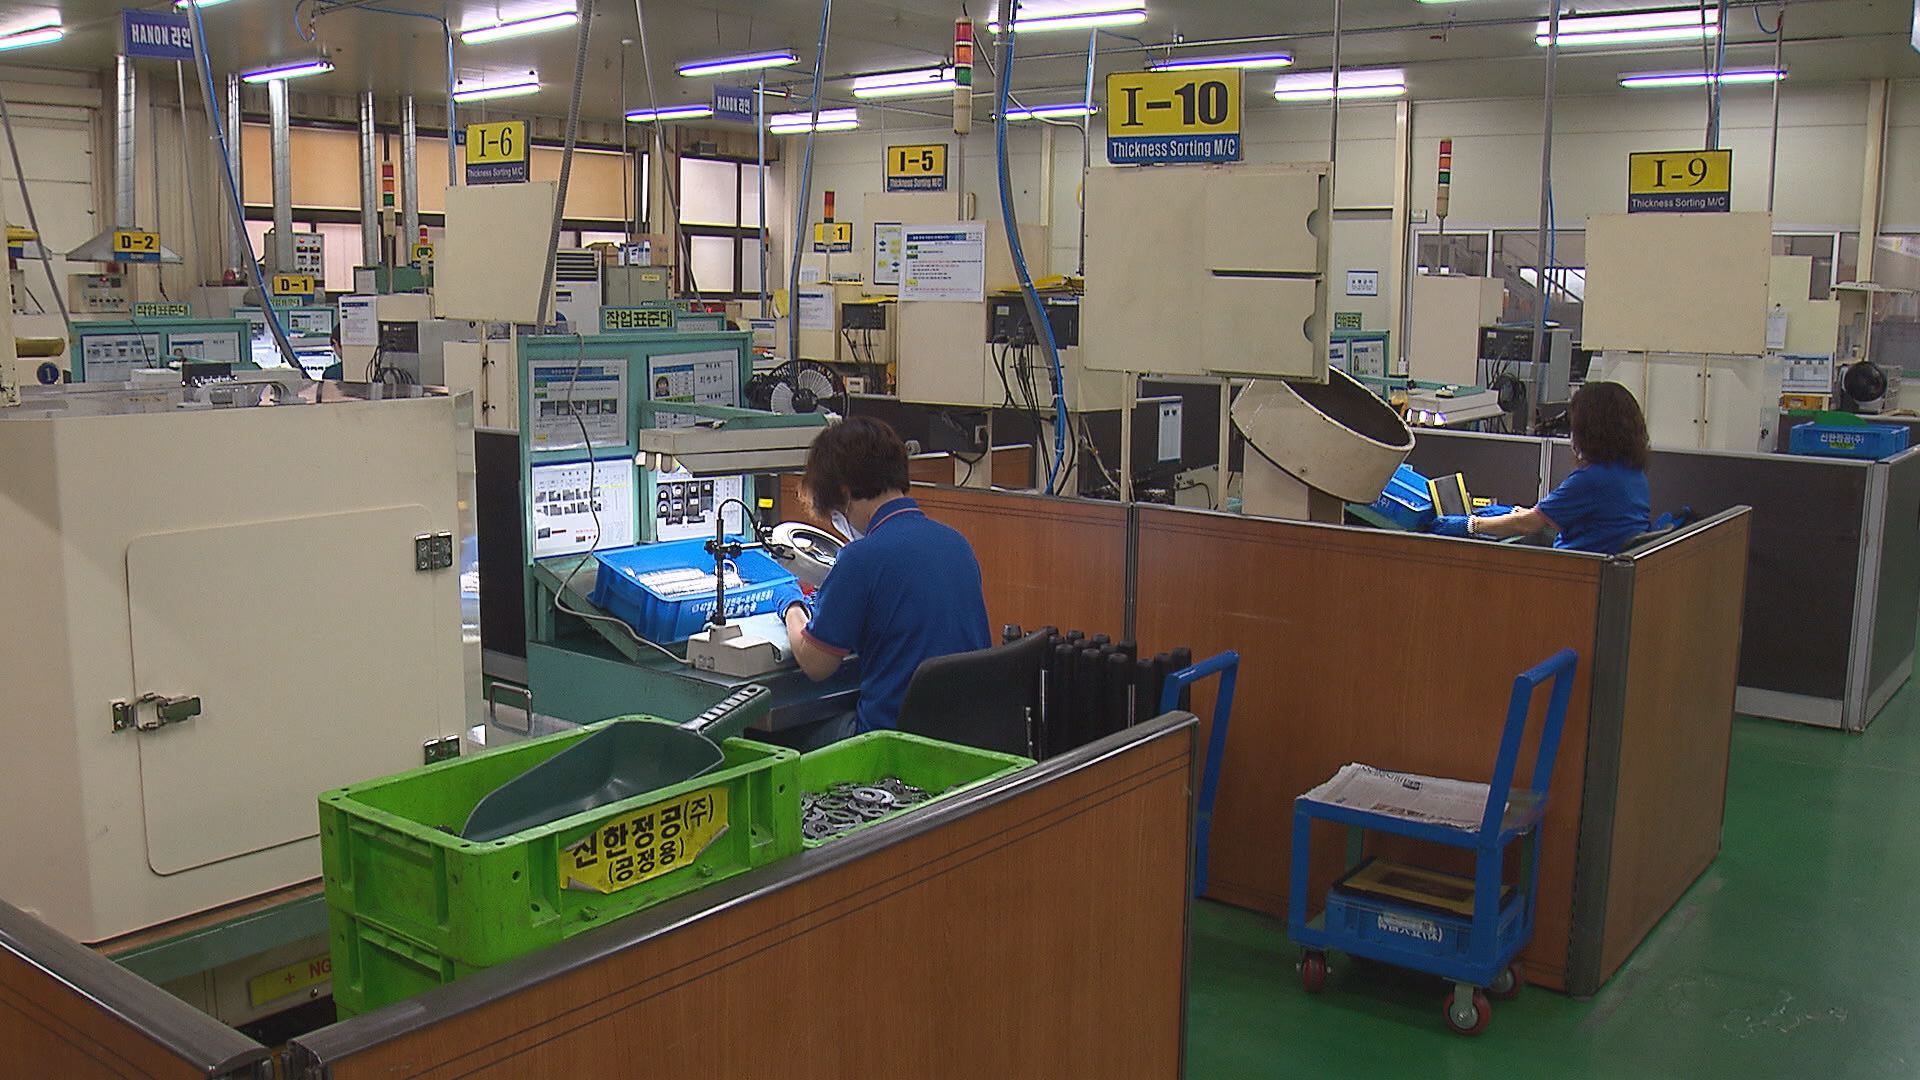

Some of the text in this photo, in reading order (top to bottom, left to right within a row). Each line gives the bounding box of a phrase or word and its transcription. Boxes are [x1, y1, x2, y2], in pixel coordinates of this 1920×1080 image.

[131, 24, 192, 48] HANON 라인
[1120, 81, 1228, 126] I-10
[479, 127, 512, 157] I-6
[1112, 139, 1235, 158] Thickness Sorting M/C
[900, 151, 933, 171] I-5
[468, 169, 491, 177] Thickness
[492, 167, 511, 177] Sorting
[1653, 158, 1708, 187] I-9
[1632, 197, 1725, 209] Thickness Sorting M/C
[121, 236, 154, 249] D-2
[281, 279, 308, 291] D-1
[606, 310, 672, 328] 작업표준대
[573, 794, 714, 869] 신한정공(주)
[608, 837, 685, 884] (공정용)
